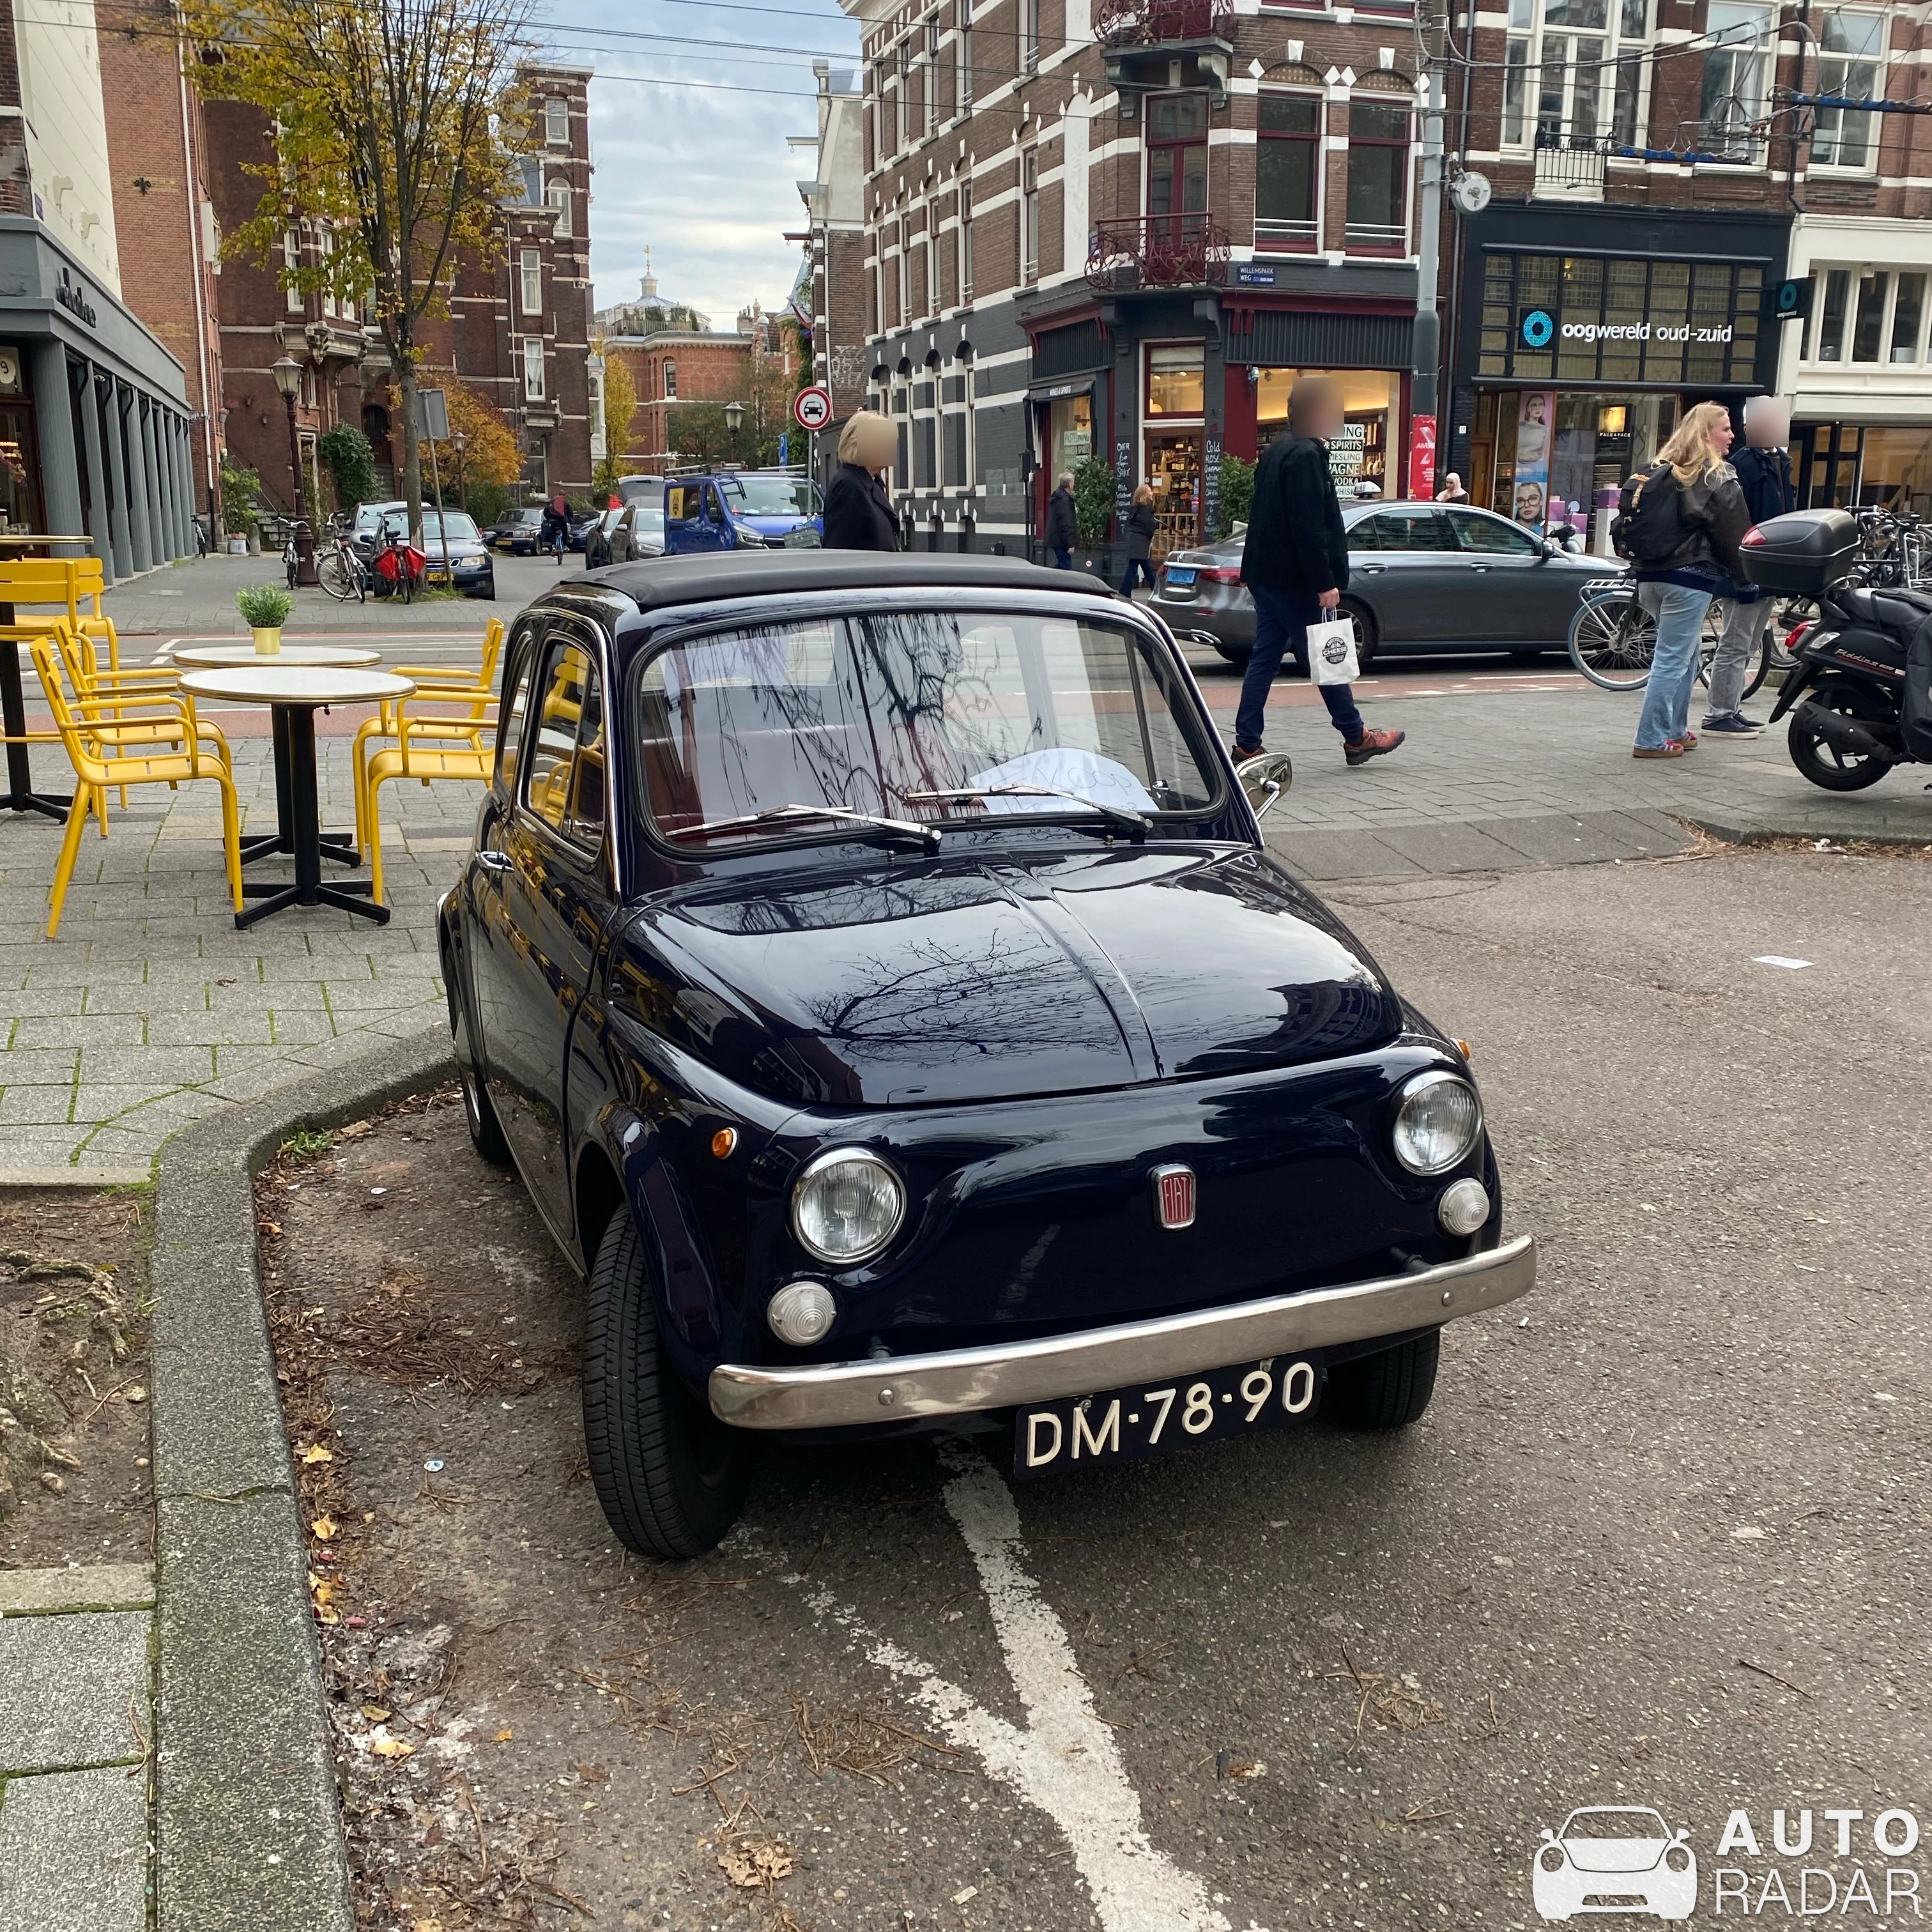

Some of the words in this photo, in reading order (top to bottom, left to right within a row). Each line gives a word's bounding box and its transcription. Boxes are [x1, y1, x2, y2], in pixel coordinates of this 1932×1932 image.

[1561, 322, 1651, 342] oogwereld
[1656, 324, 1733, 342] oud-zuid
[1206, 440, 1221, 453] Cold
[1331, 440, 1361, 450] SPIRITS
[1834, 648, 1871, 664] Fiddle
[1163, 1177, 1187, 1221] FIAT
[1026, 1361, 1315, 1468] DM-78-90
